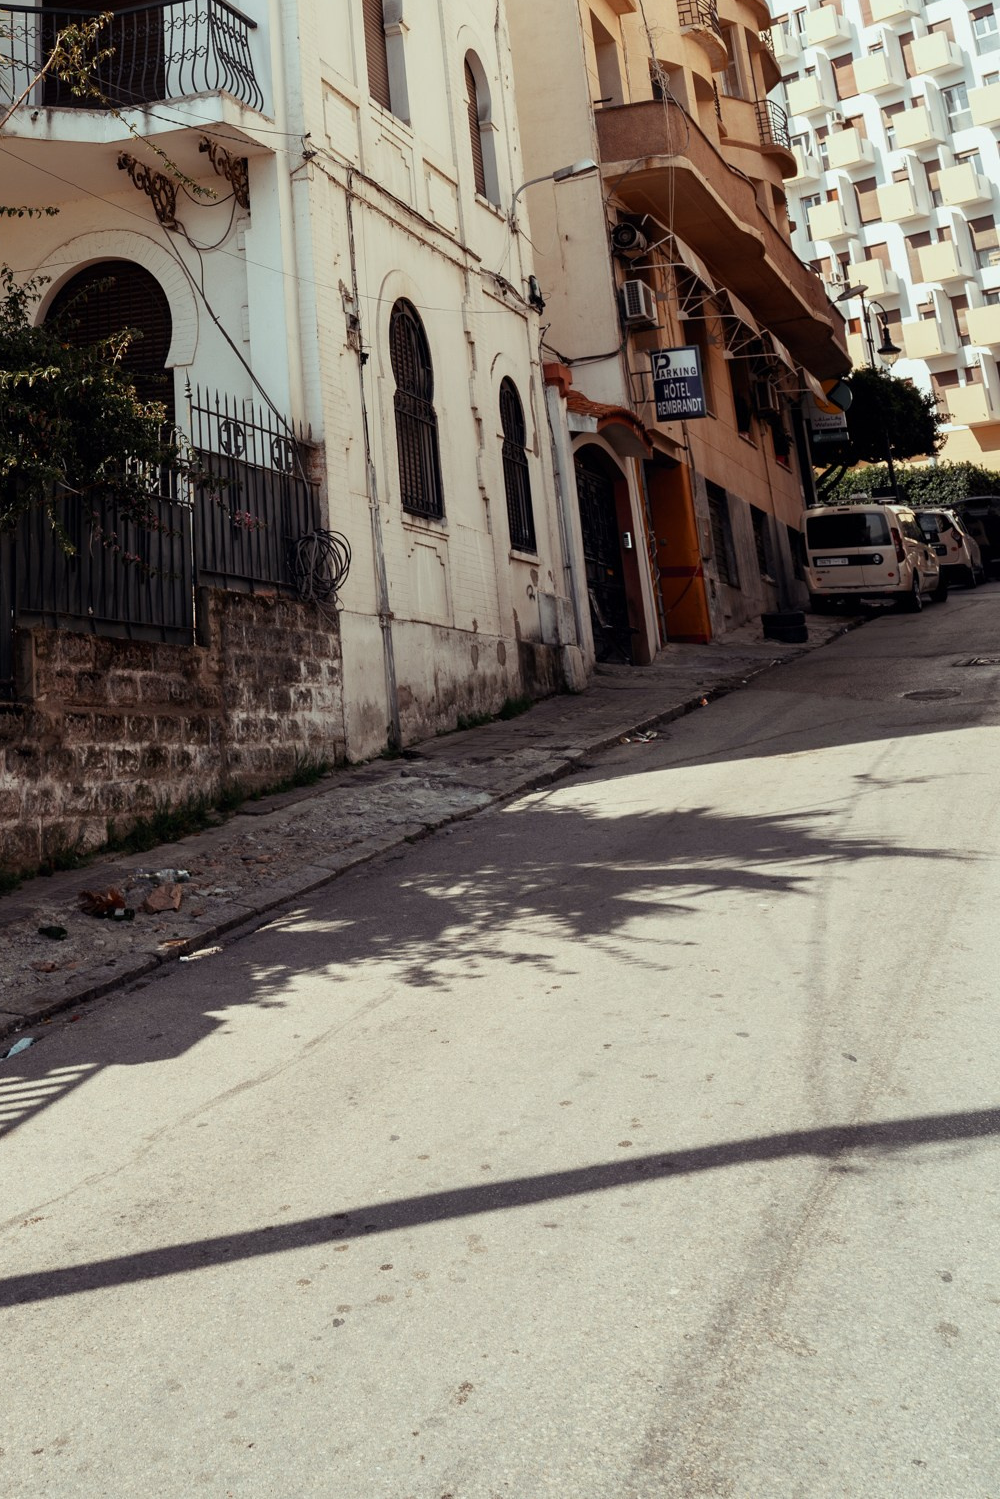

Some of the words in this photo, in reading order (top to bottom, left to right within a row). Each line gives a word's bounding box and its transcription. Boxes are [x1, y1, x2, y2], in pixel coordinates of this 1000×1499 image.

[654, 354, 697, 379] PARKING
[663, 380, 691, 398] HÔTEL
[657, 398, 702, 416] REMBRANDT
